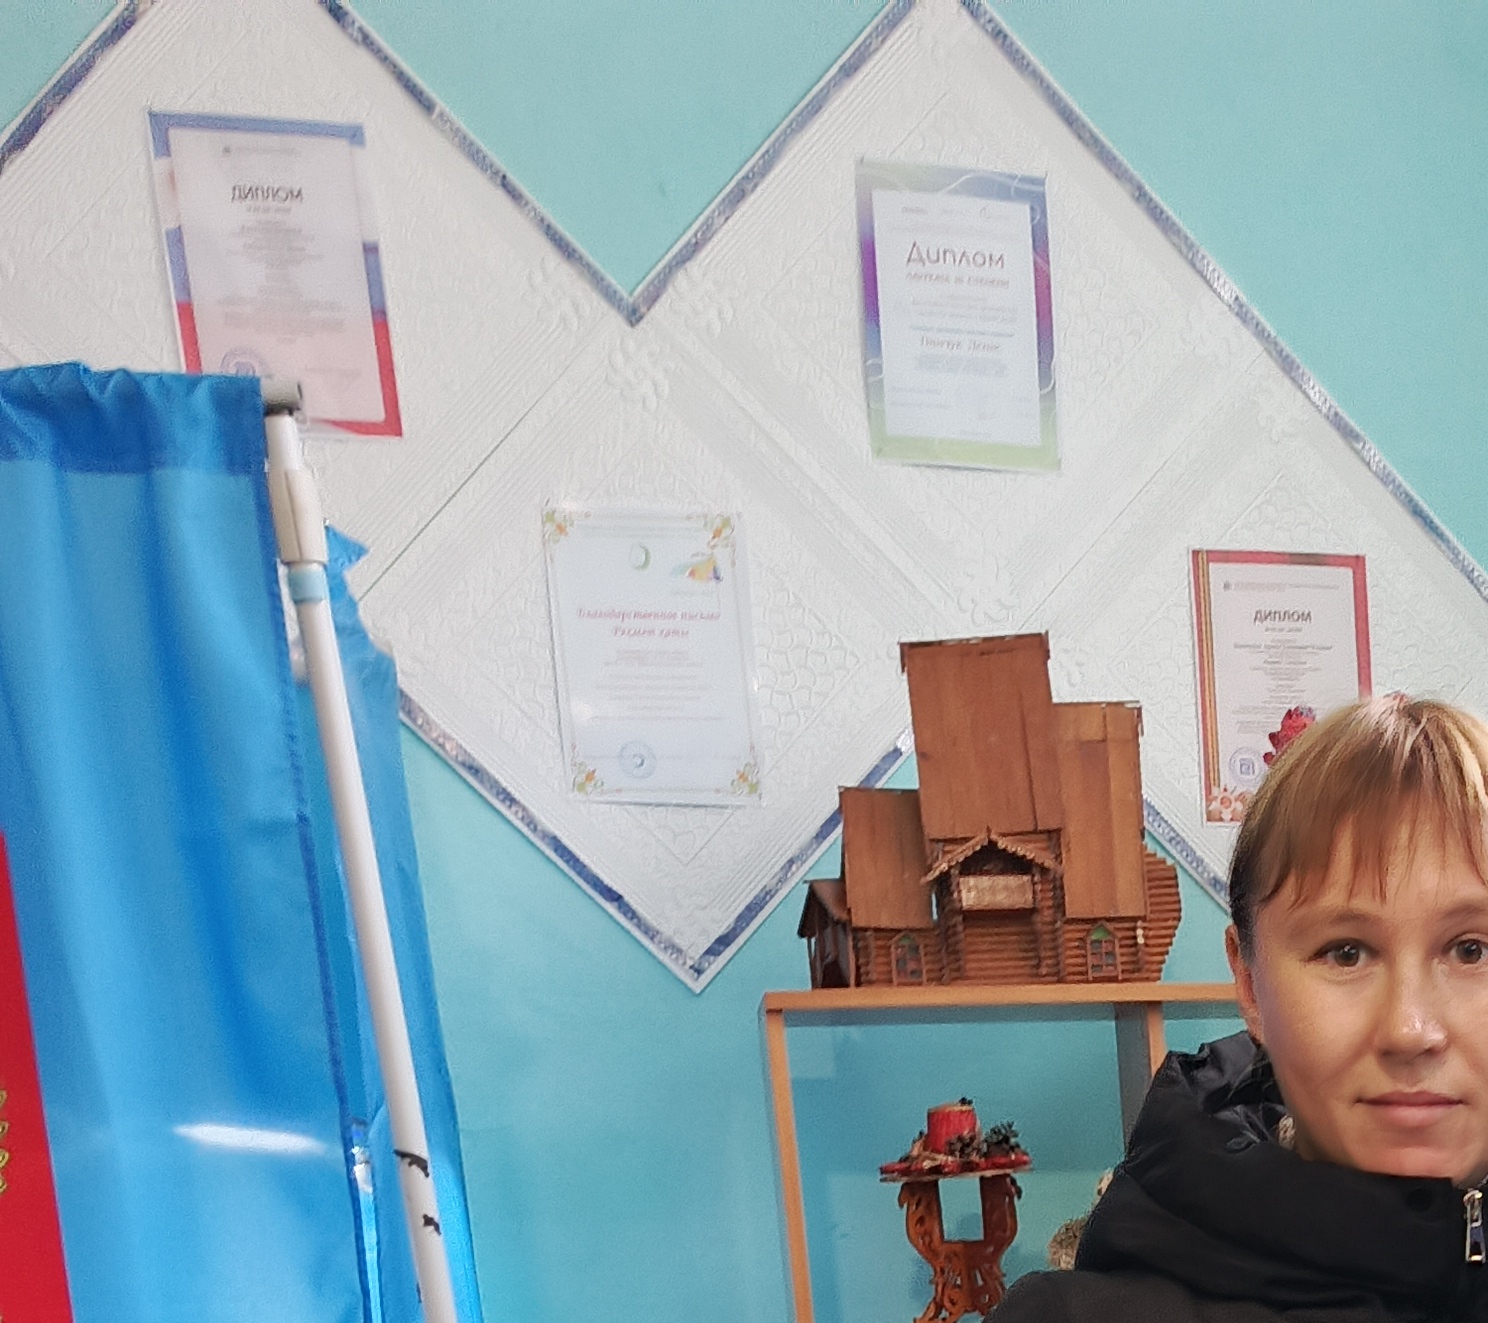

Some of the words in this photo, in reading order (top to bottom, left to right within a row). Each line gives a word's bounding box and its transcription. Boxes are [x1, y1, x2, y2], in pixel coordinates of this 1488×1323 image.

[231, 184, 304, 203] ДИПЛОМ
[906, 240, 1005, 269] Диплом
[1253, 608, 1312, 624] ДИПЛОМ
